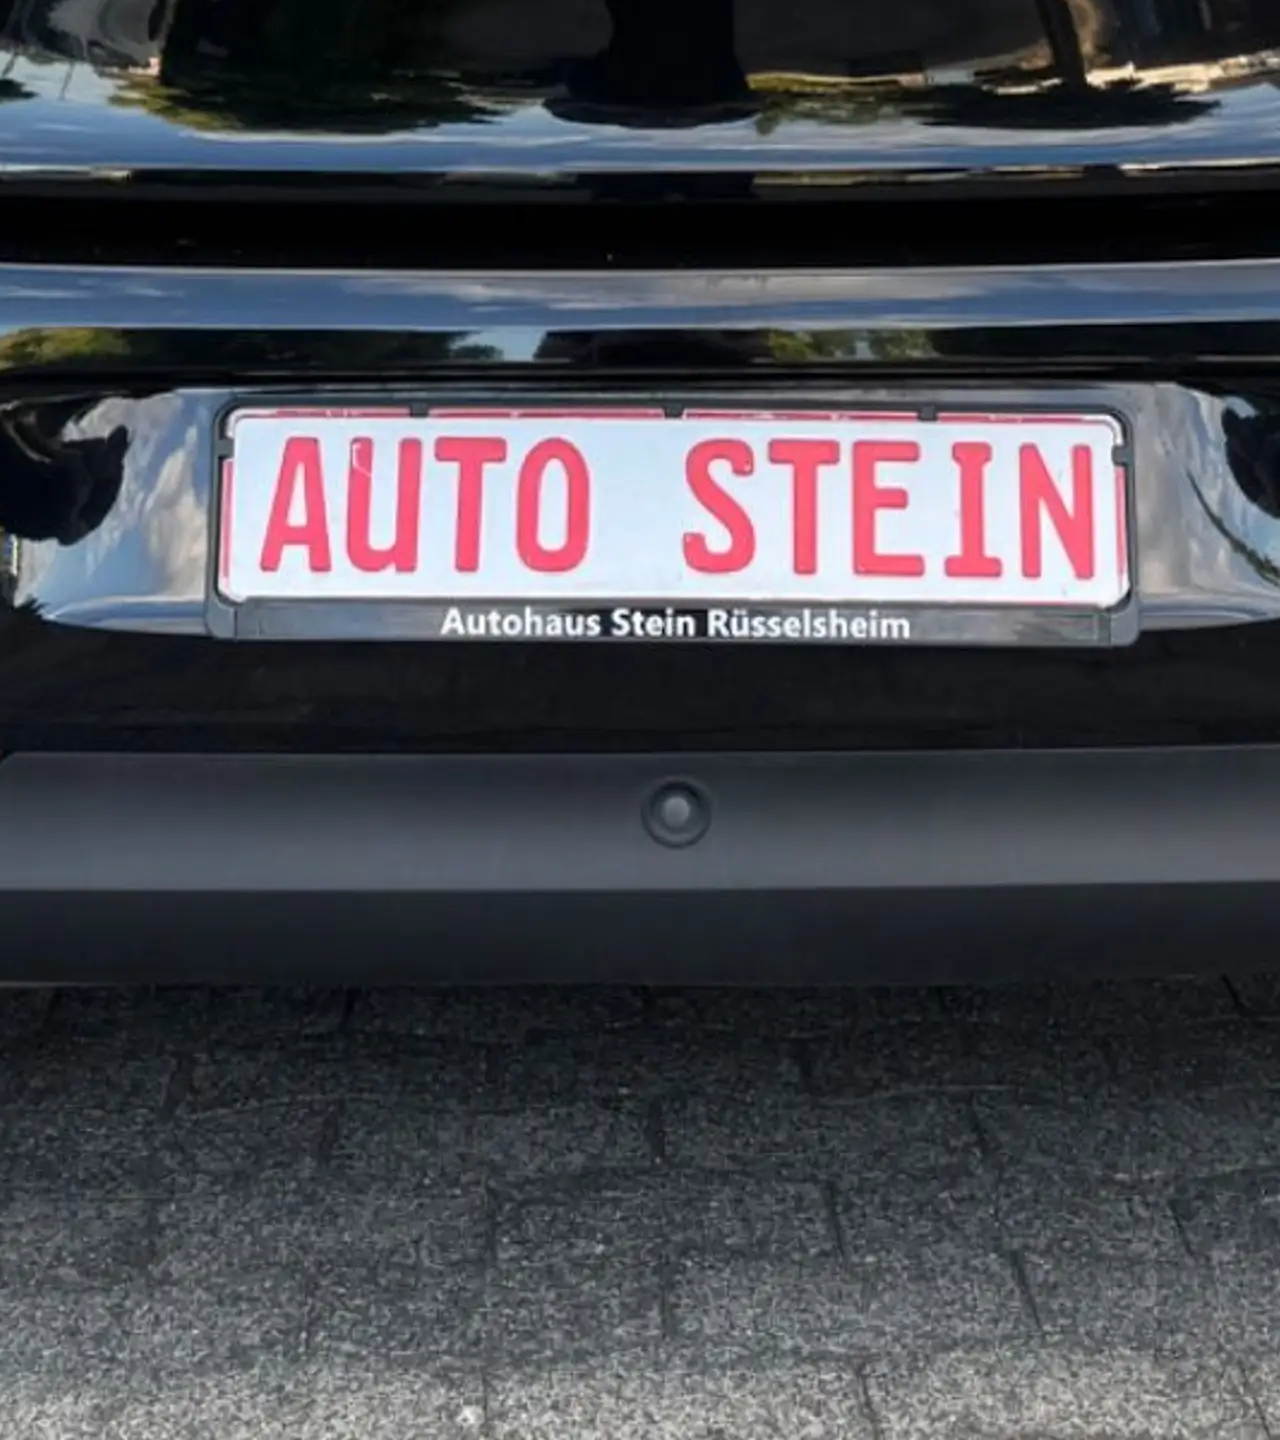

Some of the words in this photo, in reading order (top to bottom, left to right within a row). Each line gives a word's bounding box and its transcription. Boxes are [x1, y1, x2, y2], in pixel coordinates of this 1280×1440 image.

[259, 436, 591, 574] AUTO
[682, 439, 1096, 579] STEIN
[440, 606, 601, 637] Autohaus
[612, 607, 696, 637] Stein
[707, 607, 911, 640] Rüsselsheim
